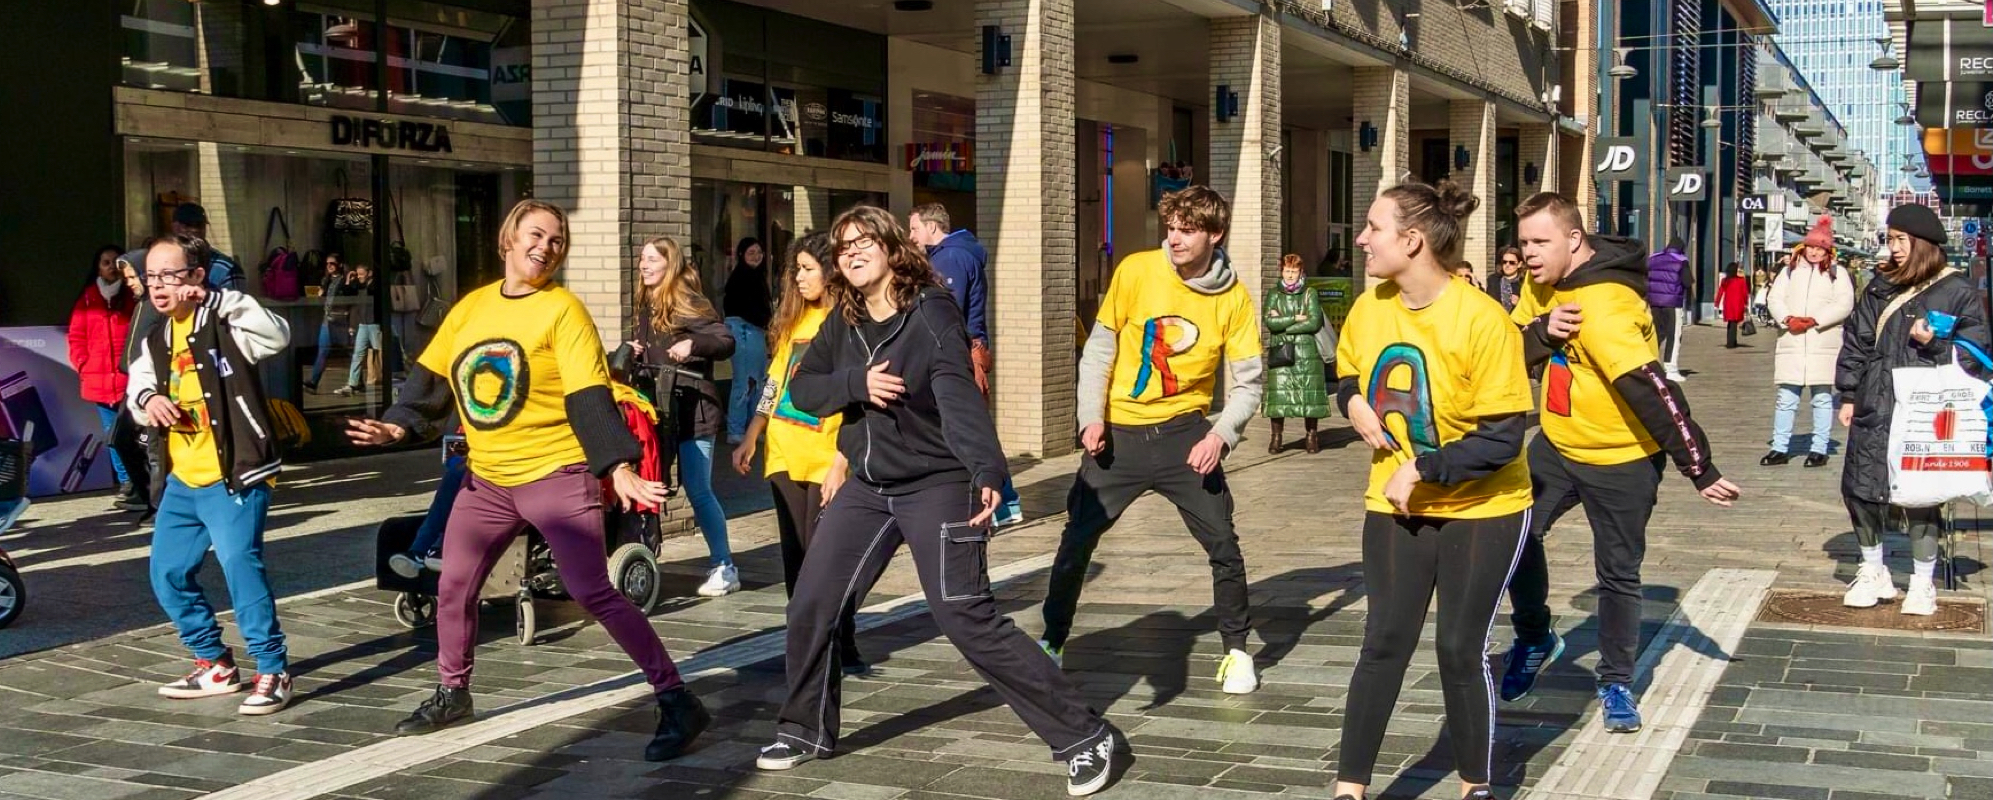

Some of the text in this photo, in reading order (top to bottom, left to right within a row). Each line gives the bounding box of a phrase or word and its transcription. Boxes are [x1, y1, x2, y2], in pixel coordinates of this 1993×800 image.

[1960, 57, 1993, 69] REC
[331, 115, 452, 152] DIFORZA
[1598, 146, 1635, 171] JD
[1672, 174, 1703, 195] JD
[1129, 314, 1200, 399] R
[1368, 342, 1441, 459] A
